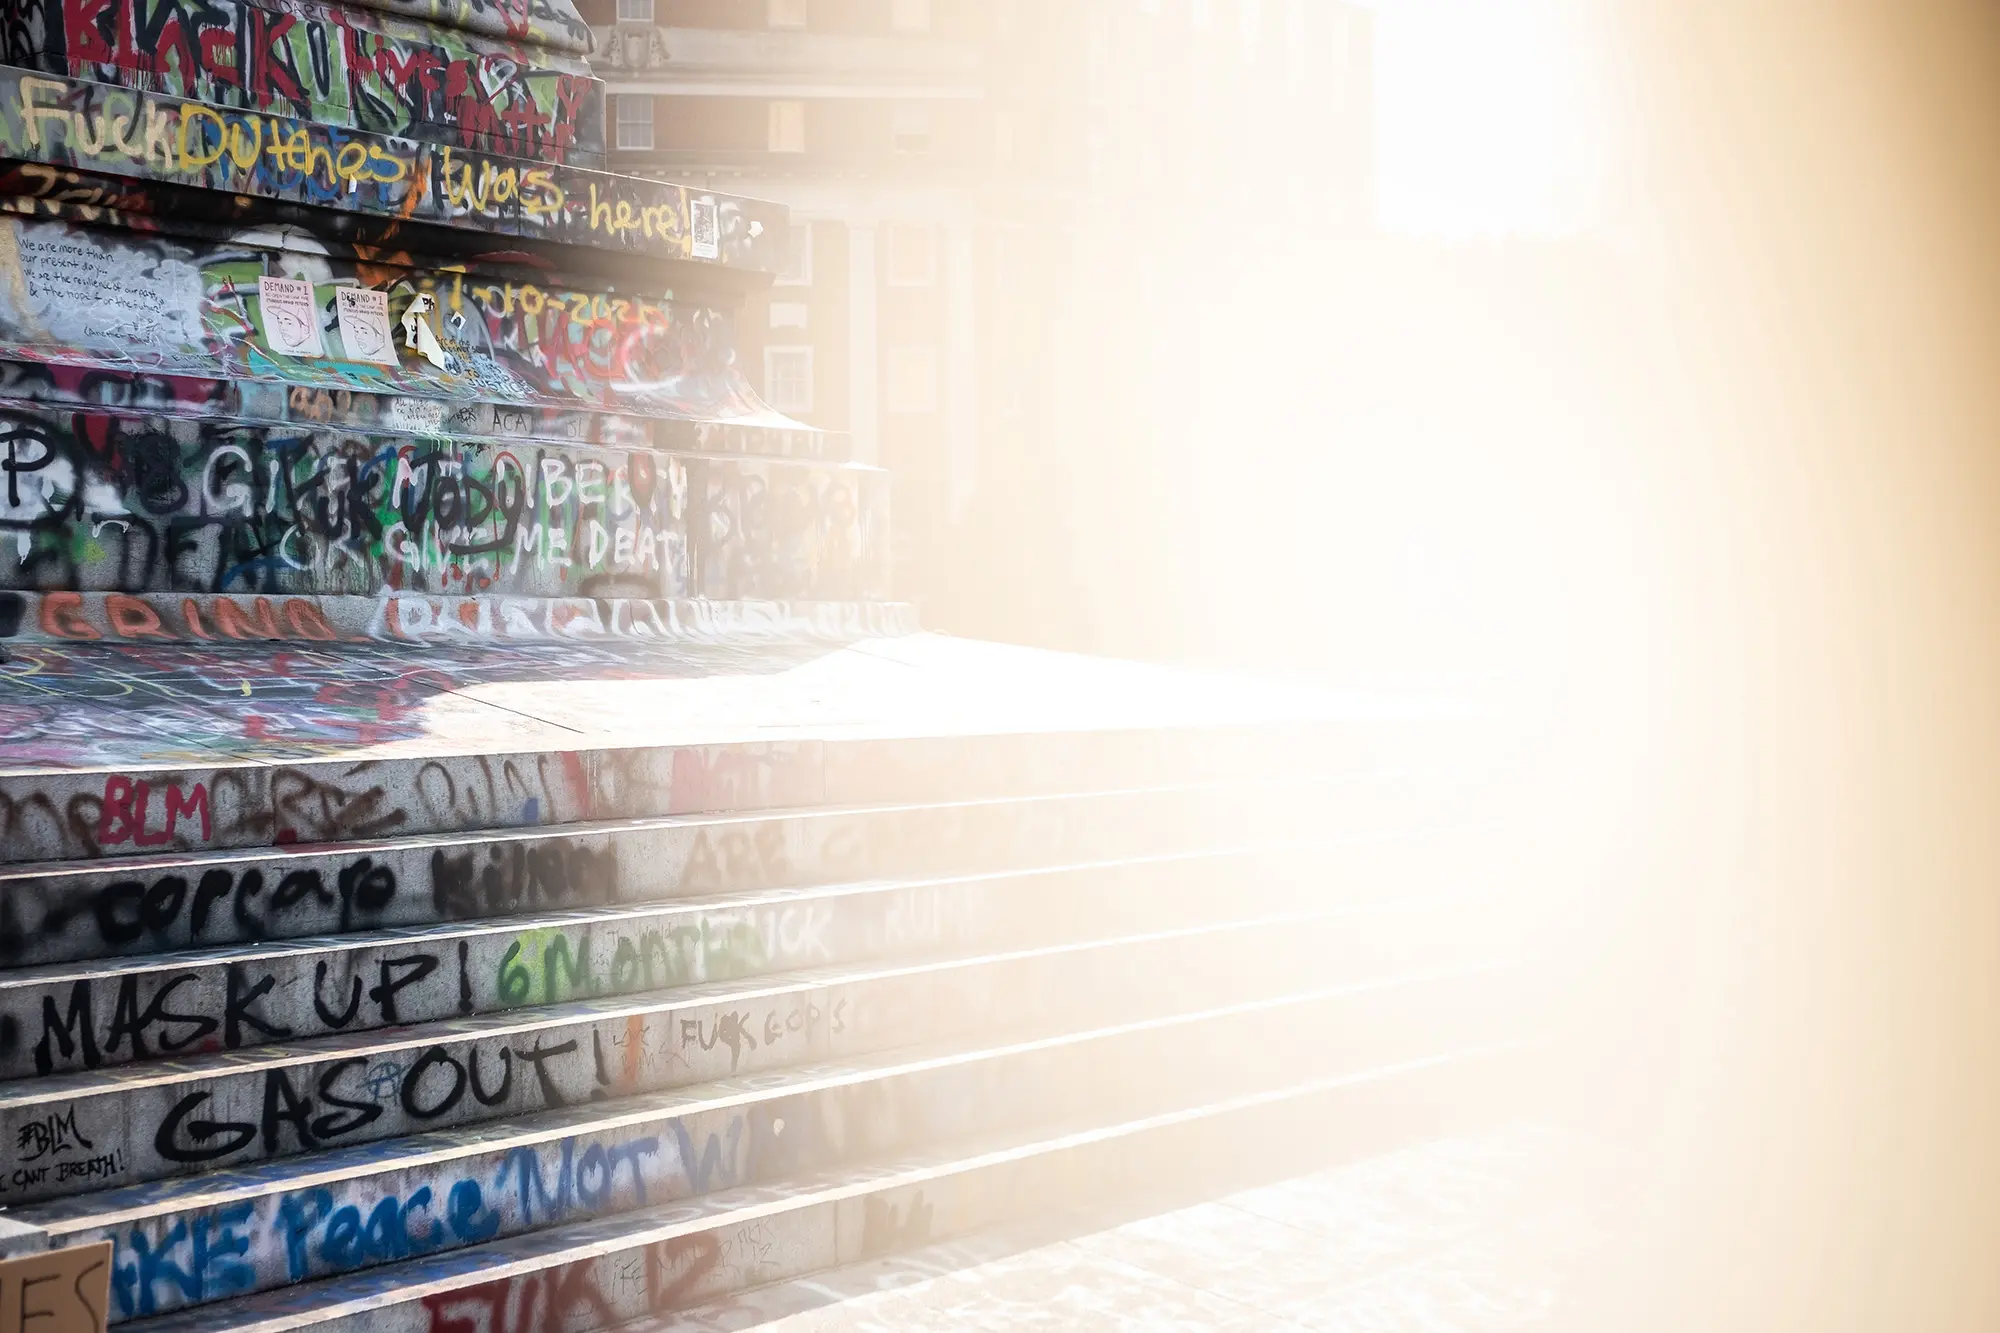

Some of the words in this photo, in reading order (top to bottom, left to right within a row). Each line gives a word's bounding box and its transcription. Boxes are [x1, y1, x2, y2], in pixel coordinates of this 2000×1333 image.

[20, 76, 174, 169] Fuck
[59, 244, 83, 256] more
[263, 280, 295, 293] DEMAND
[510, 522, 573, 575] ME
[101, 774, 211, 847] BLM
[34, 978, 293, 1077] MASK
[154, 1056, 384, 1163] GAS
[55, 1148, 126, 1183] BREATH!
[276, 1186, 500, 1285] Peace
[497, 1136, 659, 1224] NOT
